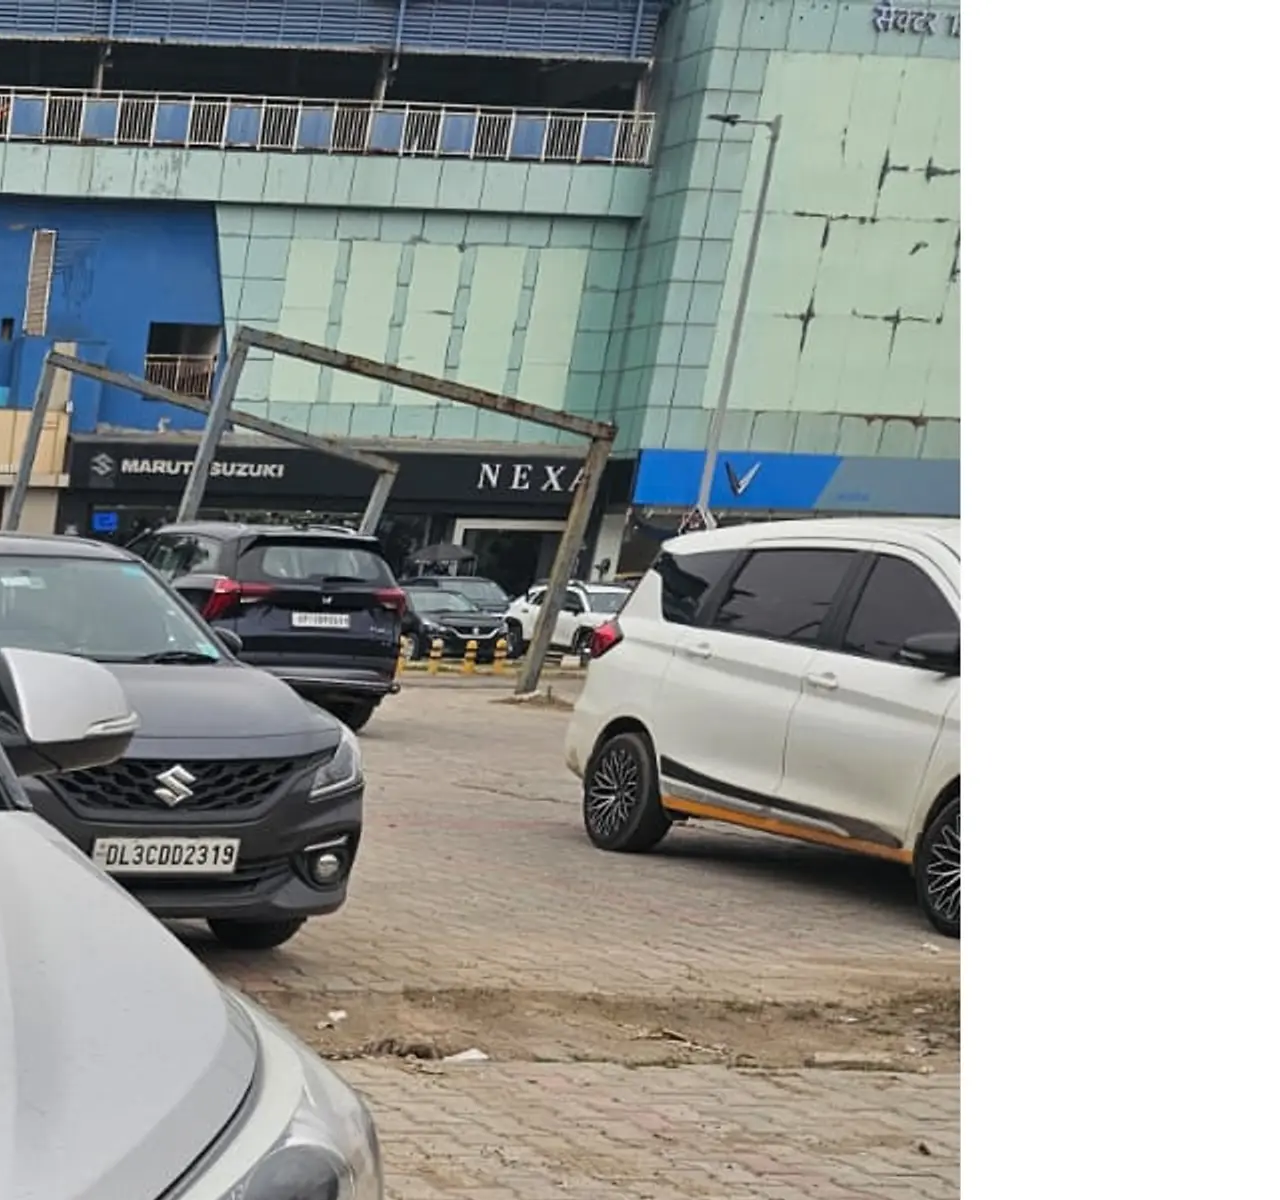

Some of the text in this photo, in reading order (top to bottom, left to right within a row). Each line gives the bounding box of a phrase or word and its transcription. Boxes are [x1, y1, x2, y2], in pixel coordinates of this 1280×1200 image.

[871, 1, 960, 37] सेक्टर 1
[121, 459, 285, 477] MARUT SUZUKI
[106, 844, 235, 866] DL3CDD2319
